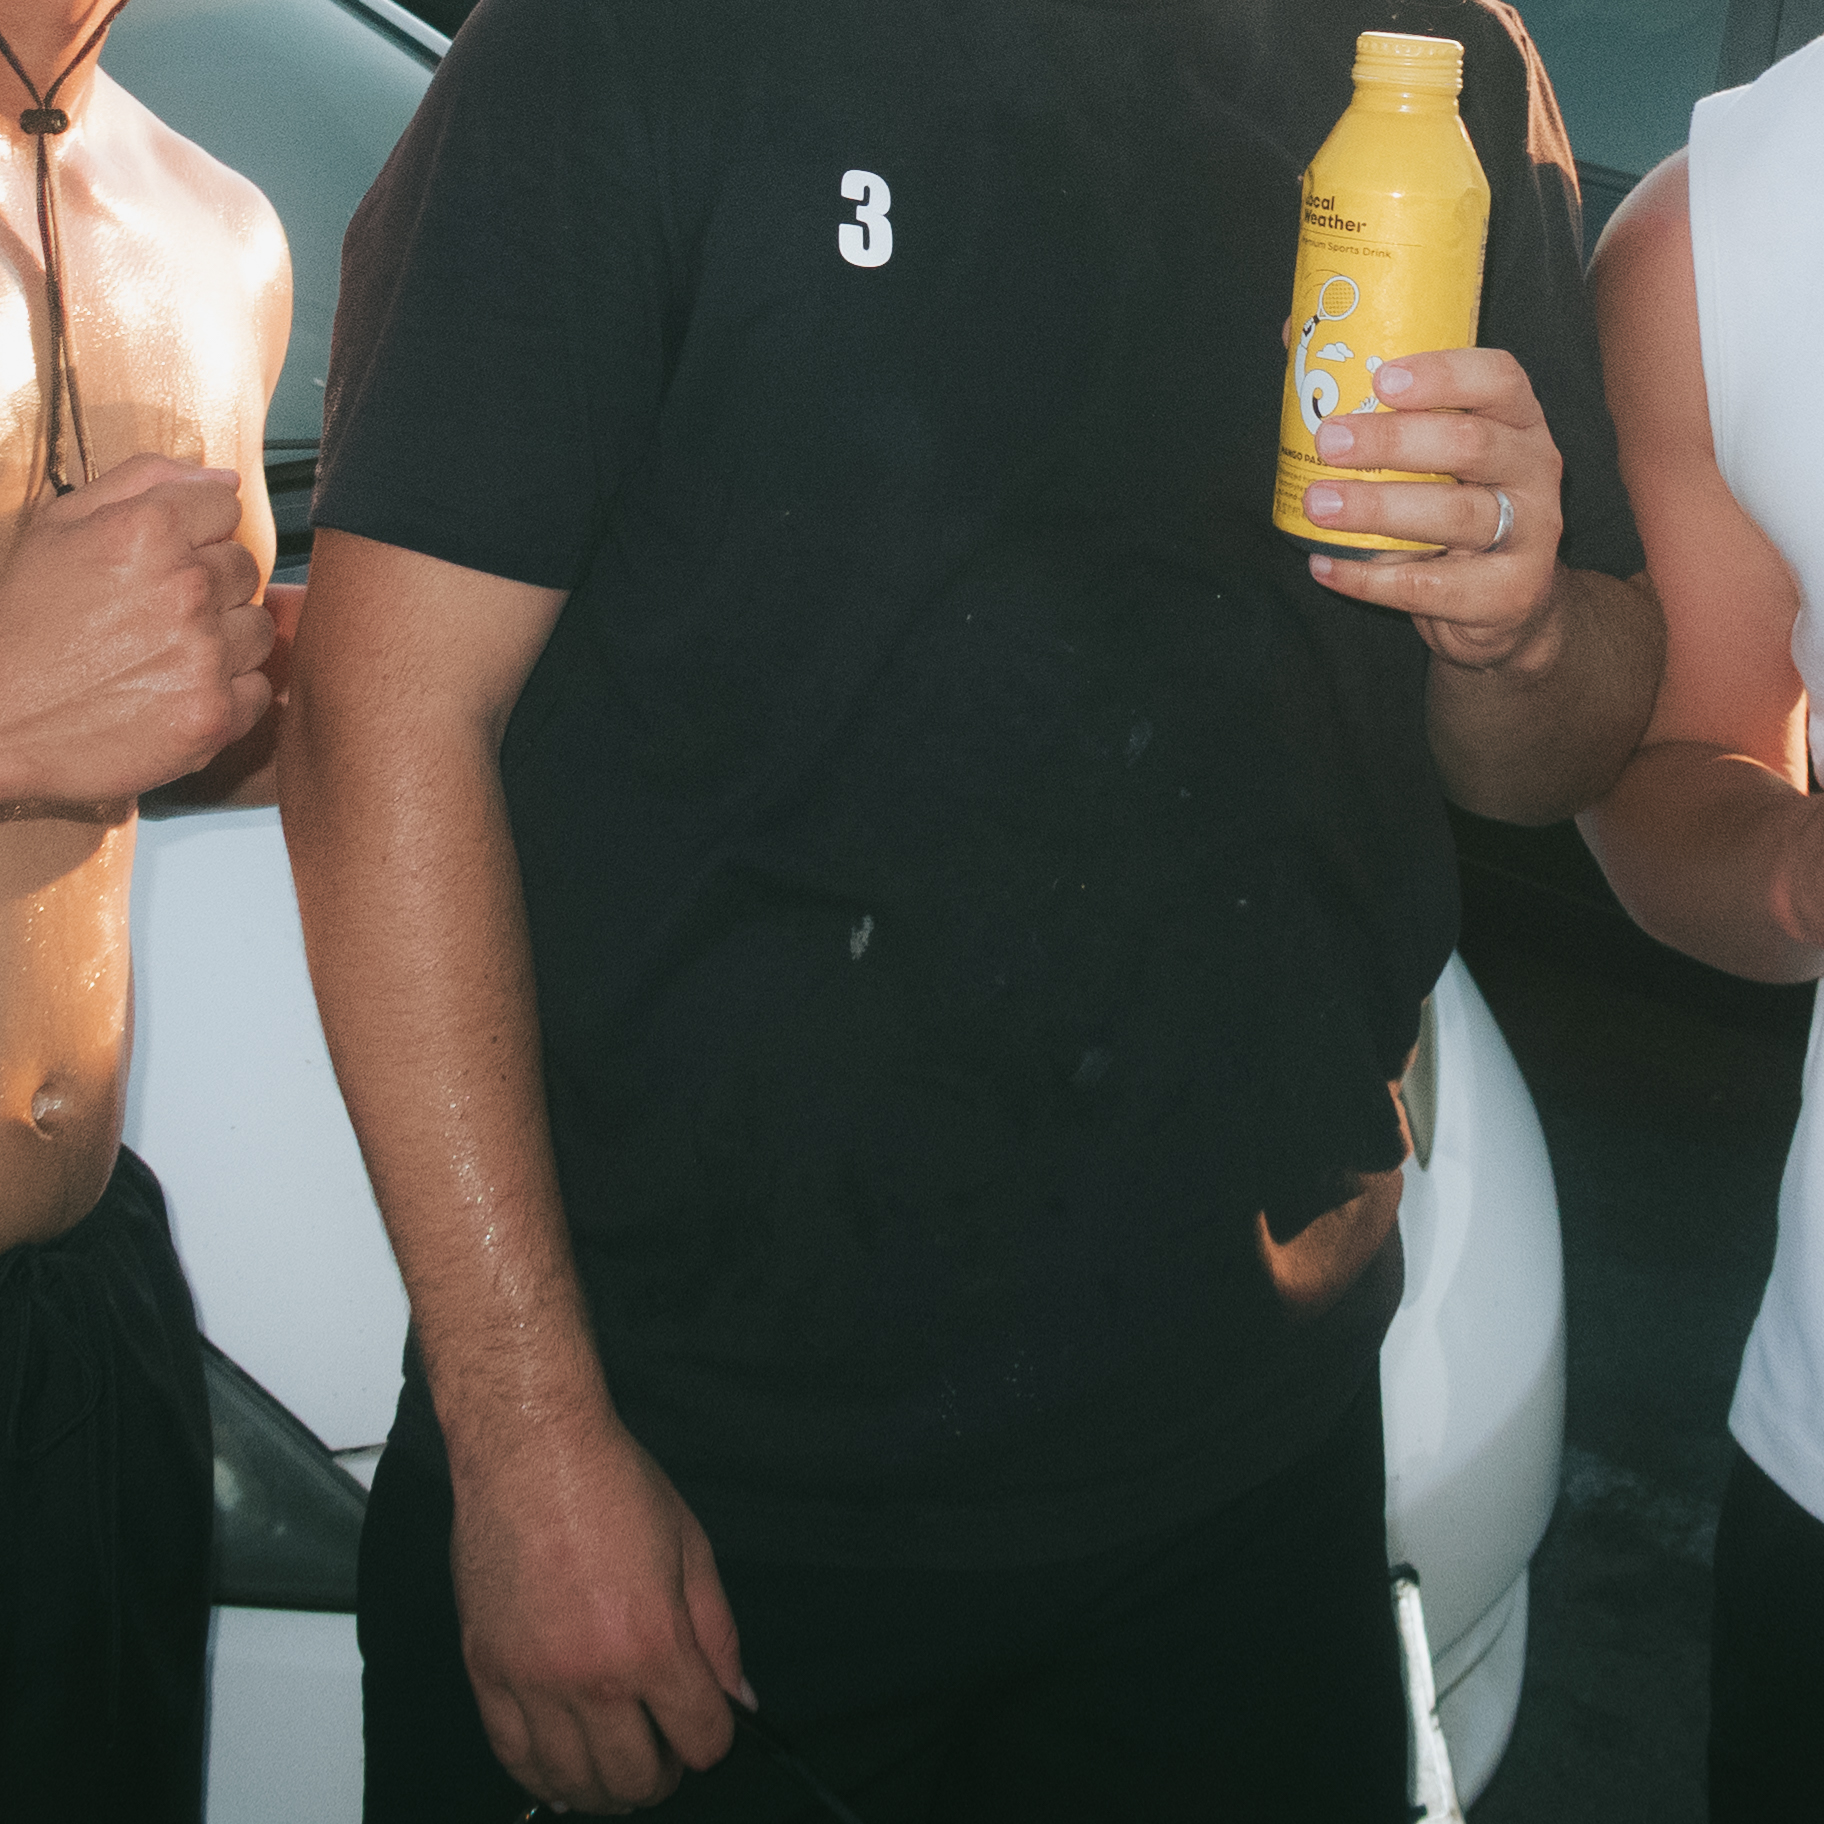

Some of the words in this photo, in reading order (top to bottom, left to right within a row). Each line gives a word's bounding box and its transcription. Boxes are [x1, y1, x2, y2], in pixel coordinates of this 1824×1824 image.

[838, 169, 893, 268] 3
[1328, 241, 1359, 255] Sports
[1363, 246, 1392, 259] Drink
